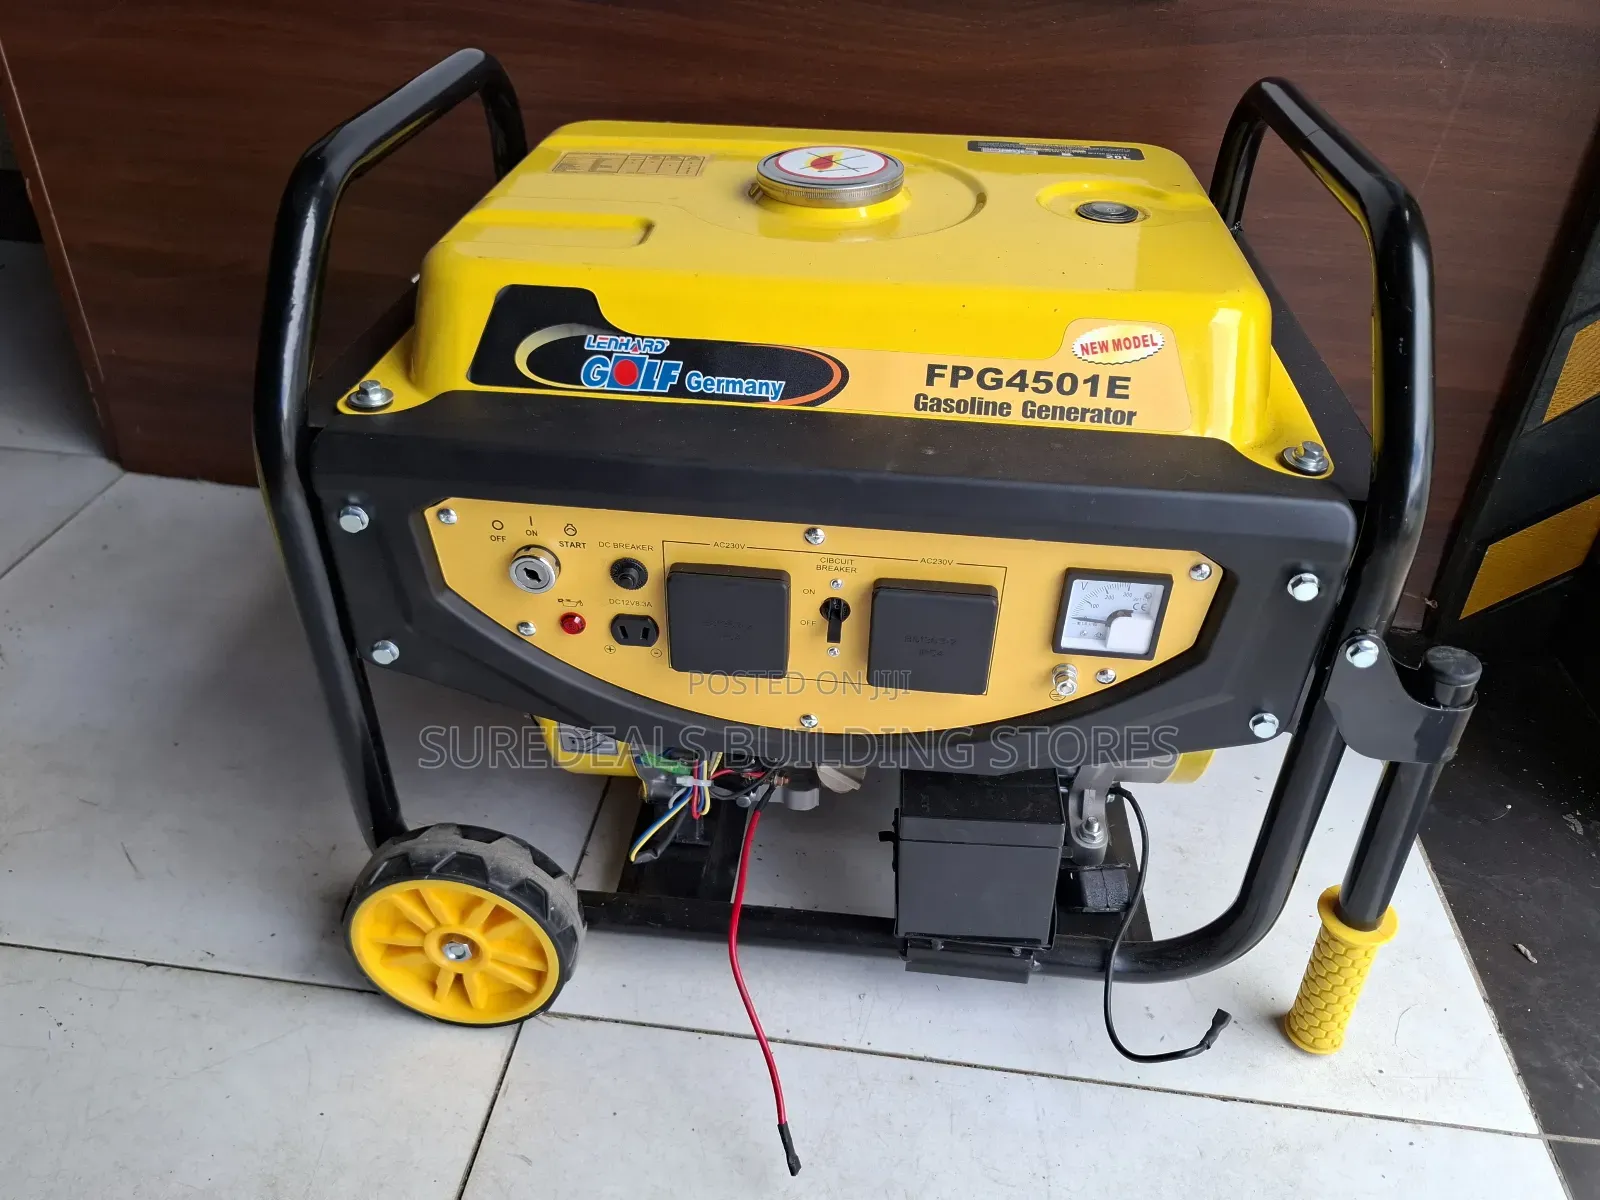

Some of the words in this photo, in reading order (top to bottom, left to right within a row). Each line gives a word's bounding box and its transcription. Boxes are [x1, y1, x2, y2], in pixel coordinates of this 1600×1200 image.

[584, 335, 668, 354] LENHARD
[1080, 340, 1109, 356] NEW
[1112, 333, 1158, 351] MODEL
[925, 363, 1131, 399] FPG4501E
[685, 371, 785, 402] Germany
[913, 392, 1012, 417] Gasoline
[1021, 399, 1137, 426] Generator
[525, 529, 538, 537] ON
[490, 534, 506, 543] OFF
[558, 540, 586, 549] START
[613, 542, 654, 552] BREAKER
[713, 540, 745, 550] AC230V
[920, 557, 954, 566] AC230V
[815, 564, 857, 574] BREAKER
